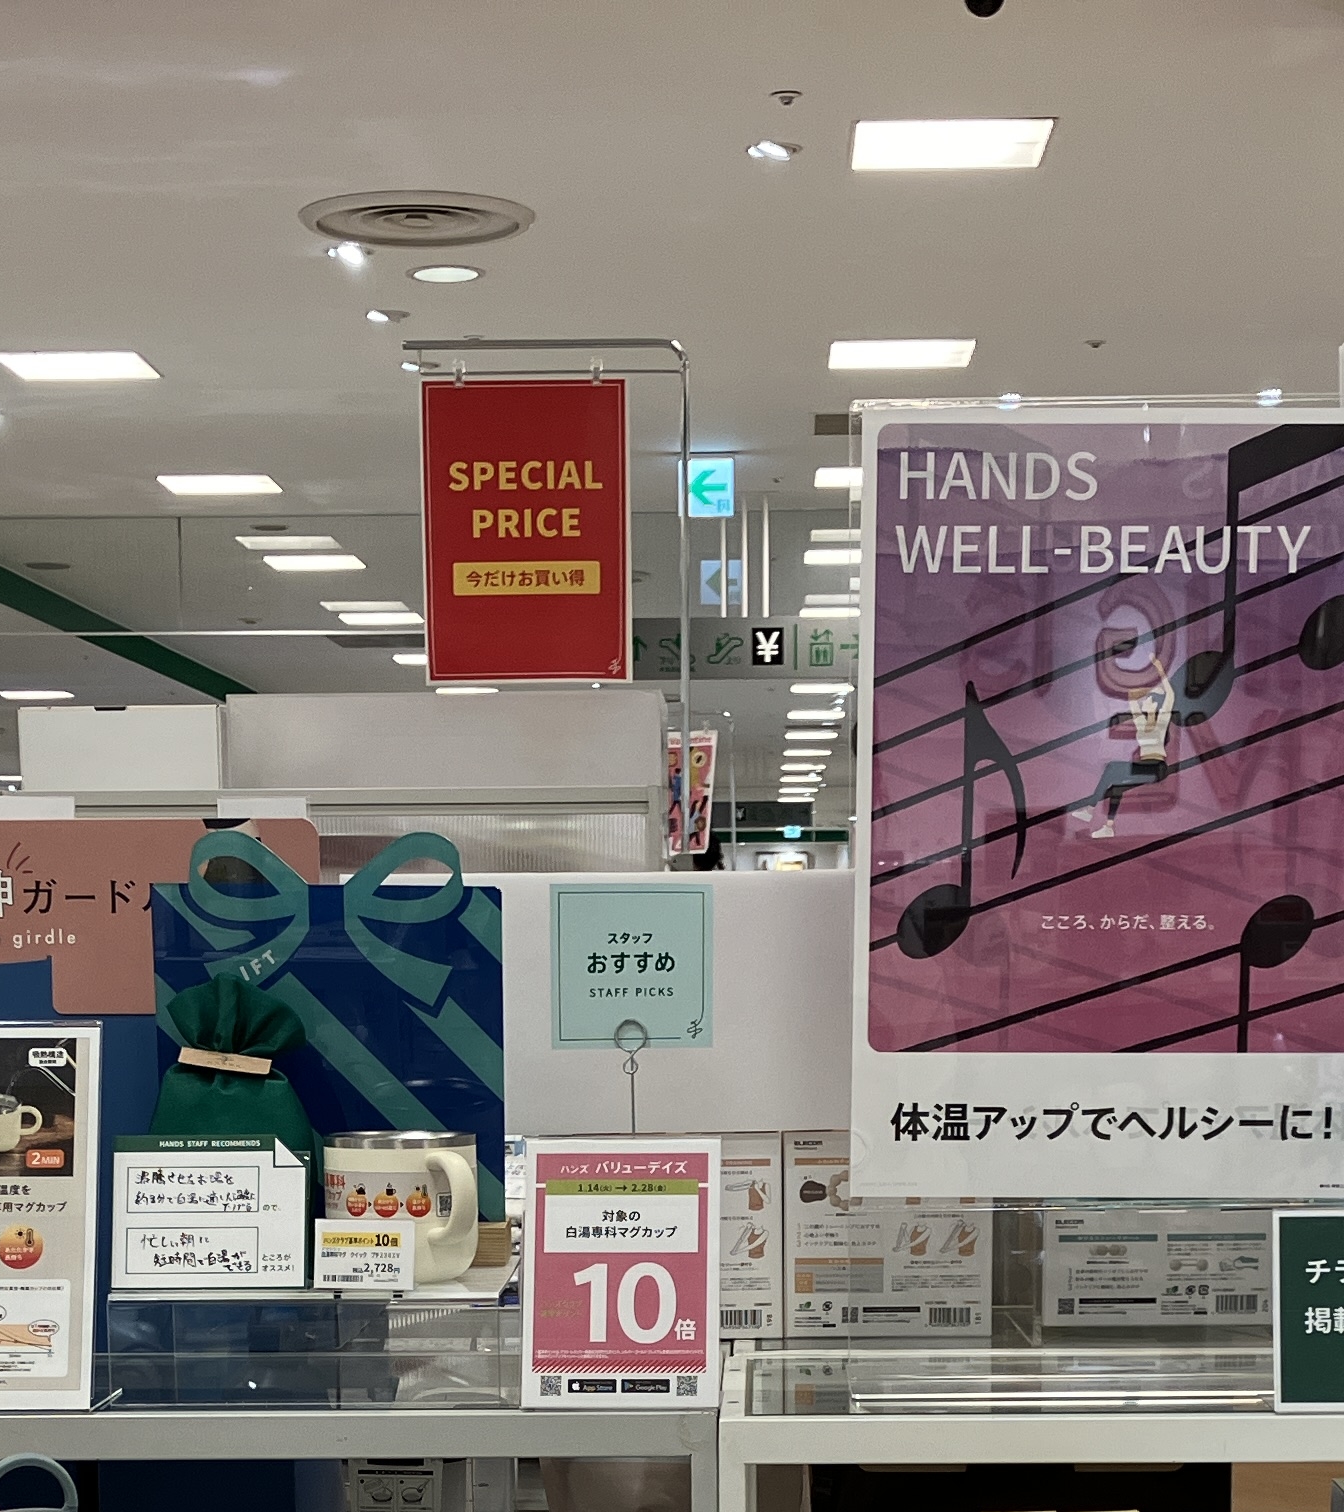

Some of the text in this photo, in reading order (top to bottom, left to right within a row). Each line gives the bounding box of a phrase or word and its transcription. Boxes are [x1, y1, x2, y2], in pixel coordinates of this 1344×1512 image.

[448, 461, 603, 491] SPECIAL
[899, 451, 1098, 500] HANDS
[472, 509, 581, 538] PRICE
[896, 526, 1311, 574] WELL-BEAUTY
[466, 569, 585, 587] 今だけお買い得
[1041, 914, 1214, 931] こころ、からだ、整える。
[13, 929, 76, 950] girdle
[607, 933, 653, 944] スタッフ
[587, 953, 675, 974] おすすめ
[589, 987, 674, 998] STAFF PICKS
[891, 1102, 1334, 1142] 体温アップでヘルシーに!
[560, 1160, 687, 1174] ハンズ バリューデイズ
[602, 1210, 640, 1222] 対象の
[566, 1225, 677, 1239] 白湯専科マグカップ
[573, 1263, 696, 1343] 10倍
